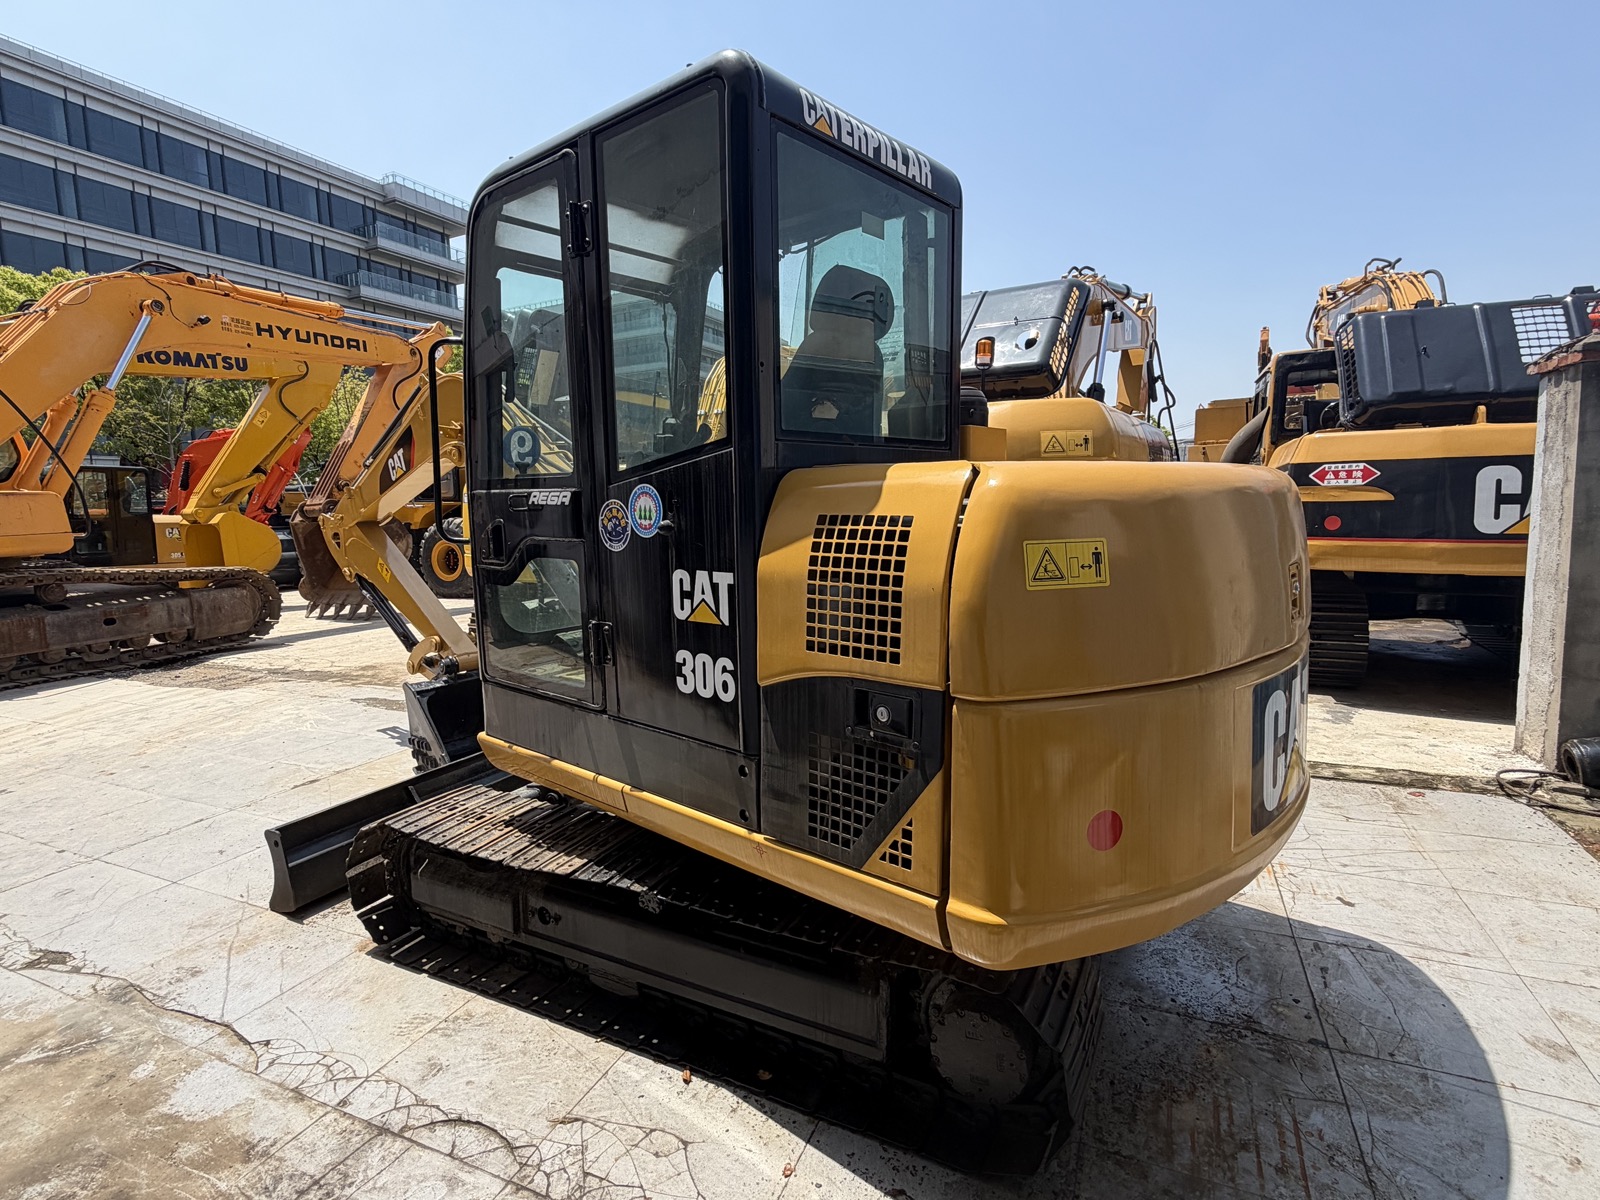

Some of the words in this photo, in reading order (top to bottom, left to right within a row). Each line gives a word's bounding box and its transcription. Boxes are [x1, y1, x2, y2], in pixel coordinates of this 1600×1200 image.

[799, 87, 932, 190] CATERPILLAR
[255, 322, 369, 353] HYUNDAI
[136, 349, 249, 372] KOMATSU
[387, 447, 407, 482] CAT
[528, 491, 572, 506] REGA
[1473, 464, 1532, 535] C
[672, 568, 735, 627] CAT
[675, 649, 736, 703] 306
